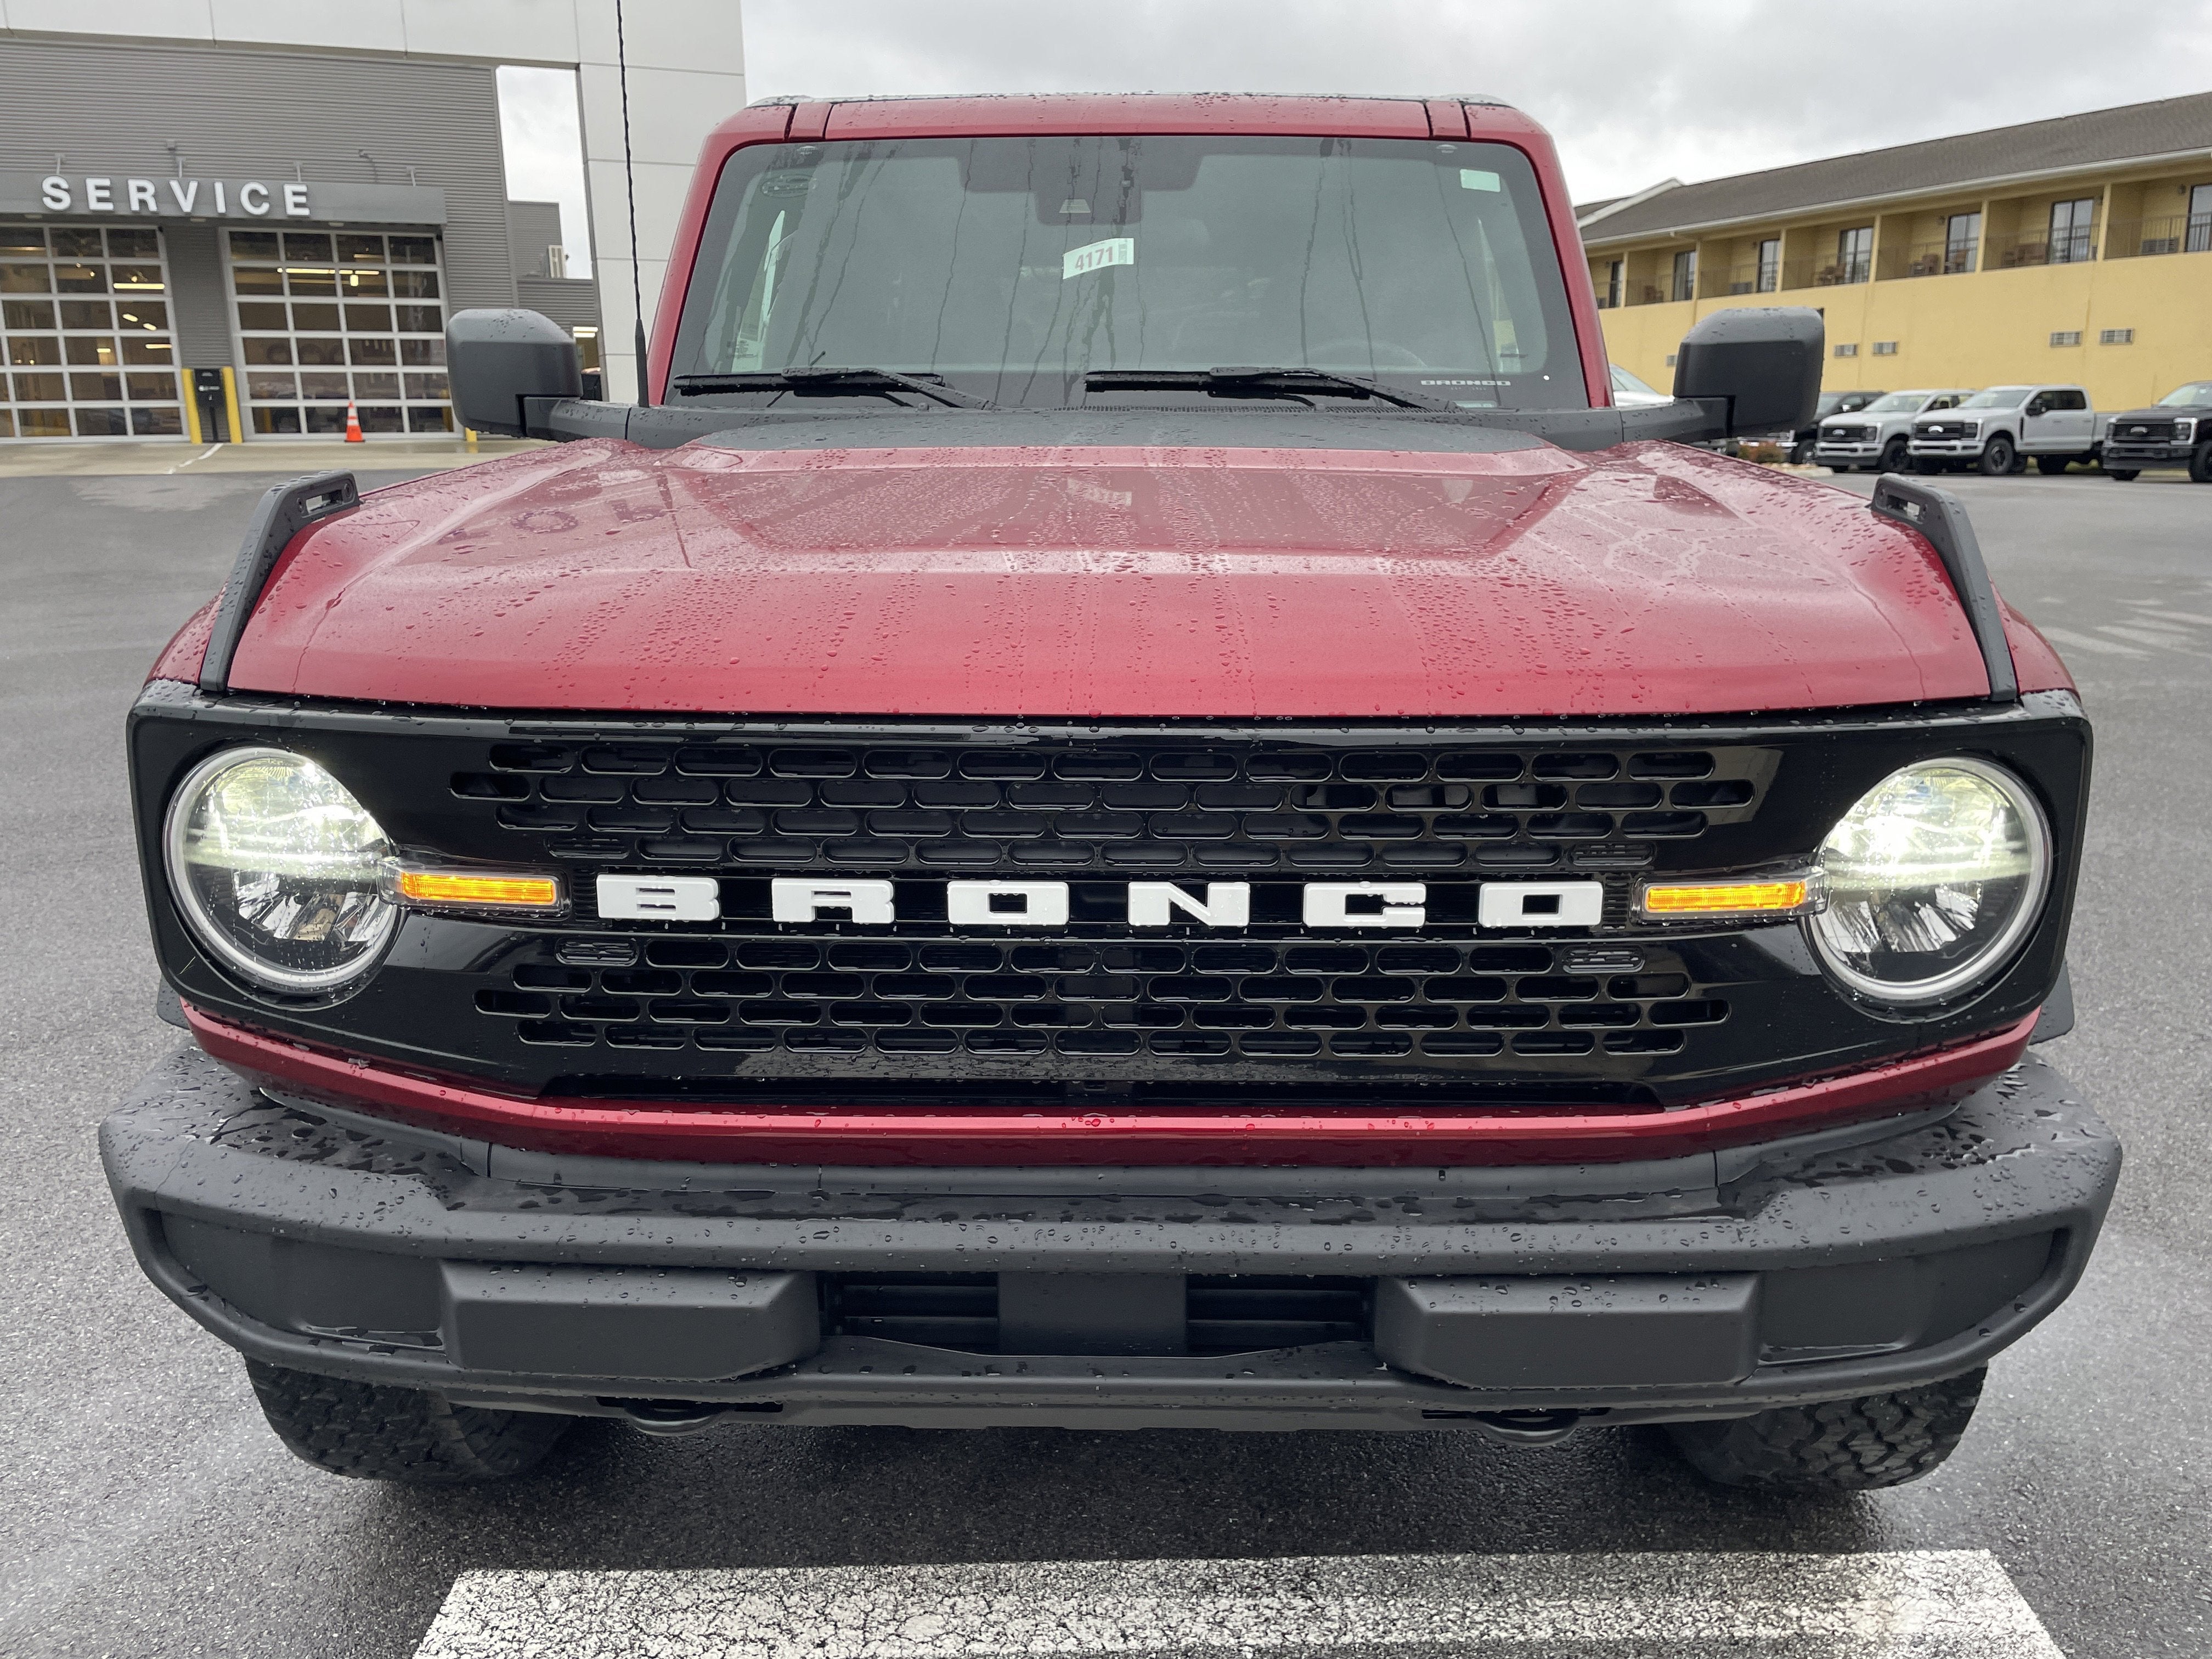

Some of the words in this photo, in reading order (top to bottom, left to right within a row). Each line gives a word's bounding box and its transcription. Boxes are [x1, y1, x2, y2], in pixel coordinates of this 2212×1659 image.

[42, 176, 311, 216] SERVICE
[1075, 246, 1113, 270] 4171
[596, 874, 1603, 927] BRONCO
